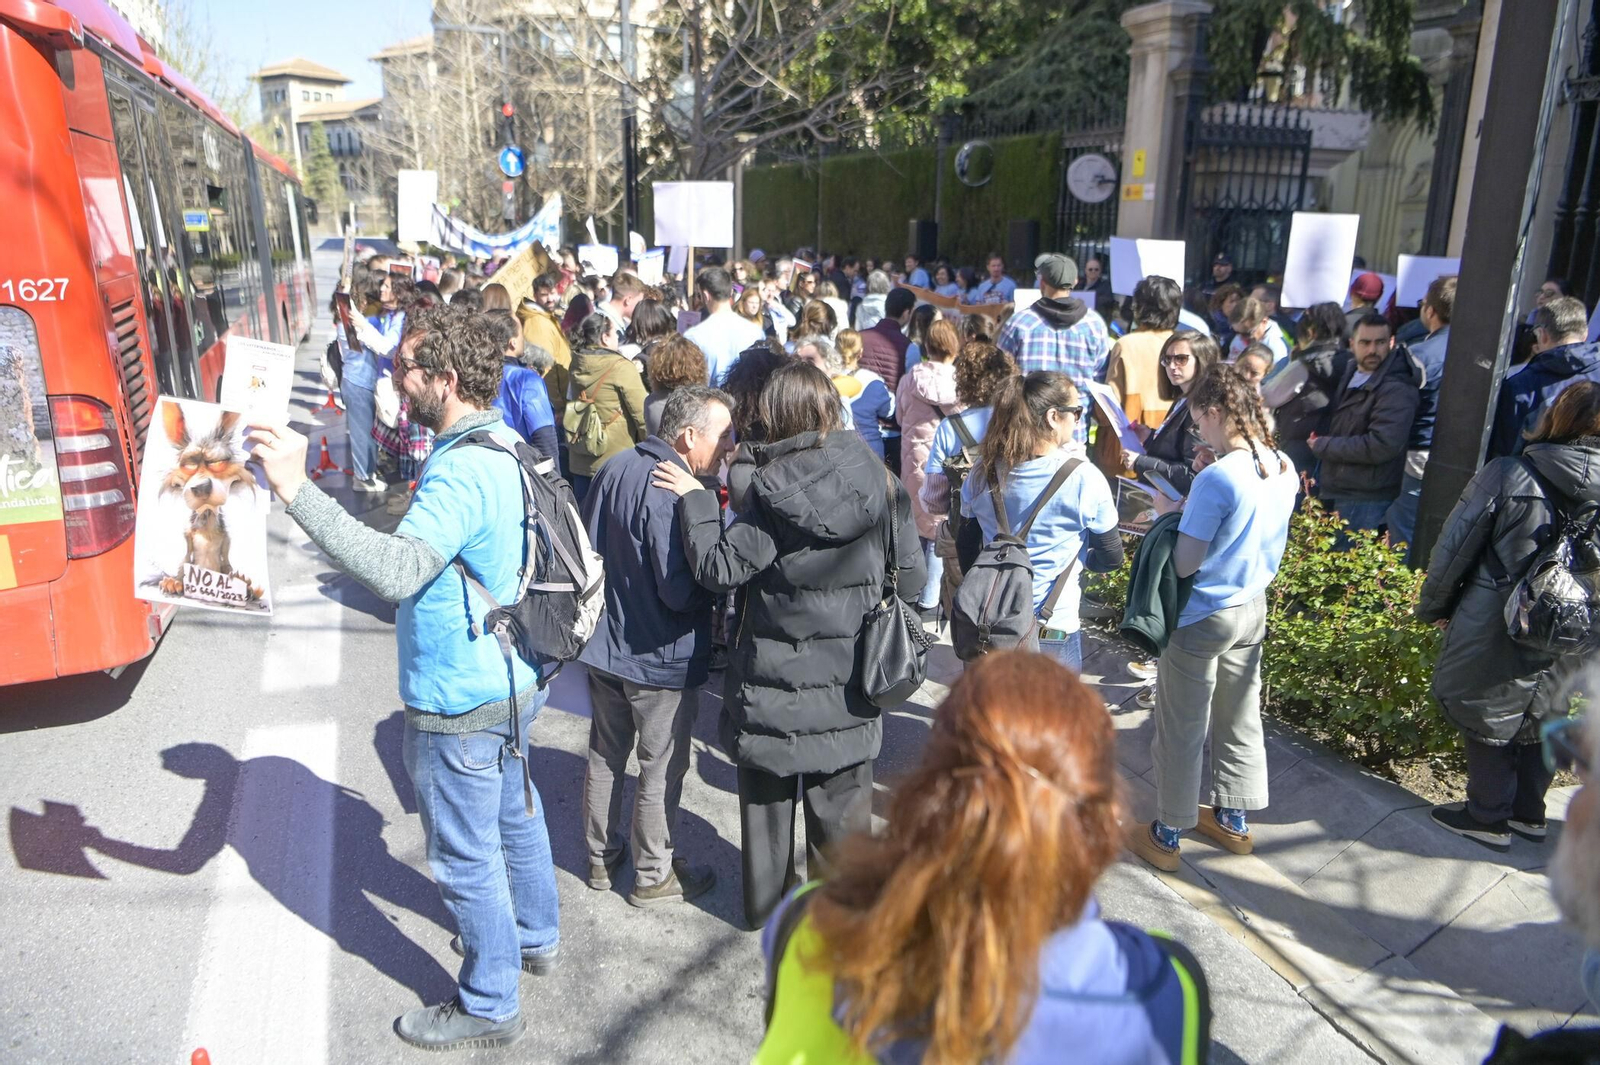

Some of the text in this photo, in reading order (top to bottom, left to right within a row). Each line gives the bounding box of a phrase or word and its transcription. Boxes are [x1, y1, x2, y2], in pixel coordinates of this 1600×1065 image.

[1, 277, 70, 302] 1627
[0, 496, 58, 509] ndalucía
[188, 565, 232, 590] NO AL
[184, 584, 197, 593] RD
